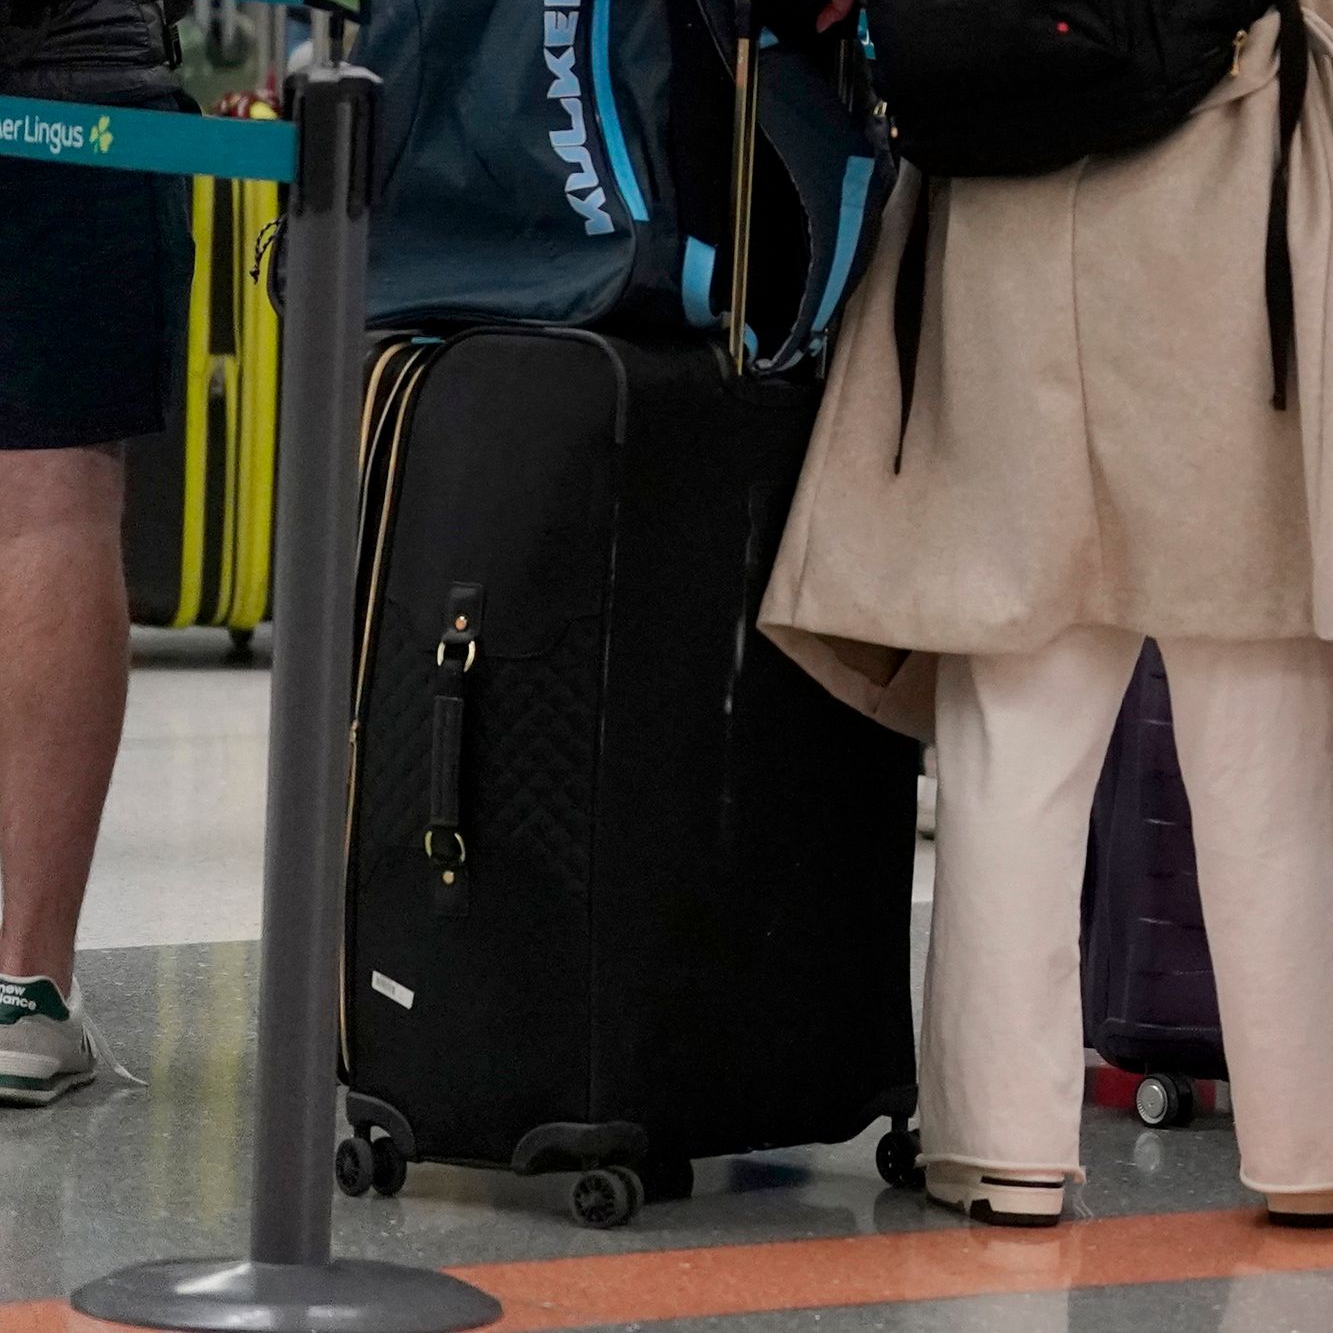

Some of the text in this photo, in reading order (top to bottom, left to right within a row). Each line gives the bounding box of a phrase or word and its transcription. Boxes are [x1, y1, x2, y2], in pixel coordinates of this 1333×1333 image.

[24, 115, 84, 155] Lingus
[0, 984, 26, 996] new
[0, 993, 37, 1011] lance
